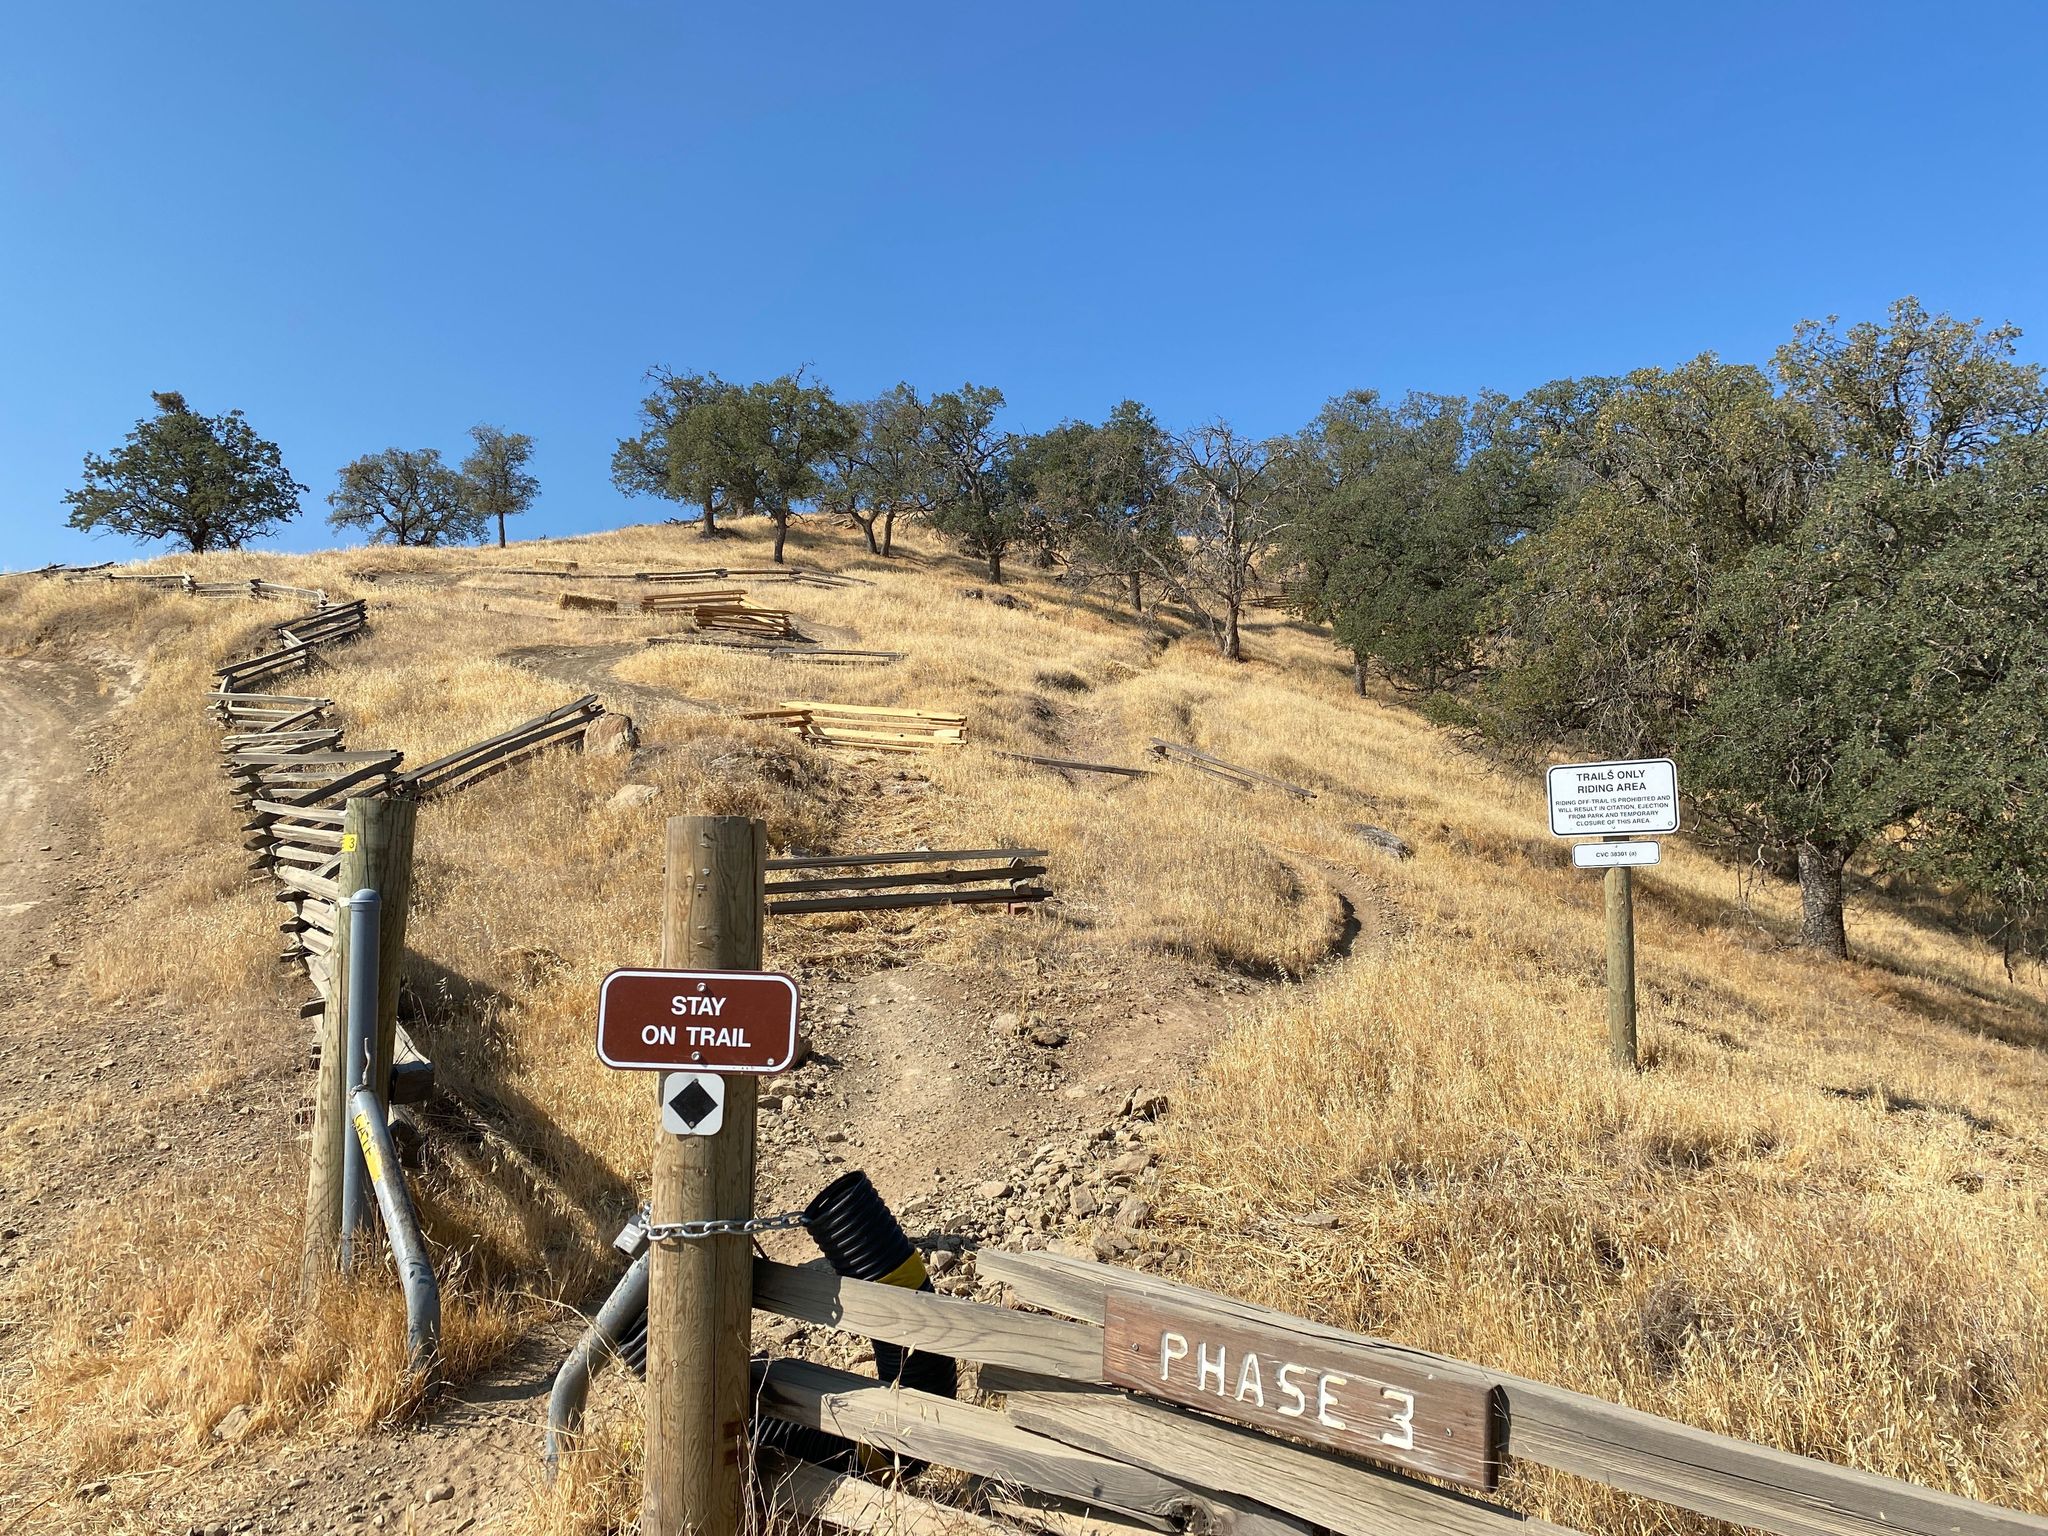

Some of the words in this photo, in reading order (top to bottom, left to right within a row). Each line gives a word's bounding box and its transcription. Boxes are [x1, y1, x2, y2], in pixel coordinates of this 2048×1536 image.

[1576, 771, 1614, 782] TRAILS
[1617, 770, 1646, 779] ONLY
[1578, 784, 1614, 793] RIDING
[1616, 782, 1646, 791] AREA
[349, 838, 355, 848] 3
[671, 996, 726, 1017] STAY
[641, 1025, 676, 1045] ON
[686, 1026, 752, 1048] TRAIL
[1160, 1331, 1348, 1430] PHASE
[1380, 1387, 1415, 1450] 3
